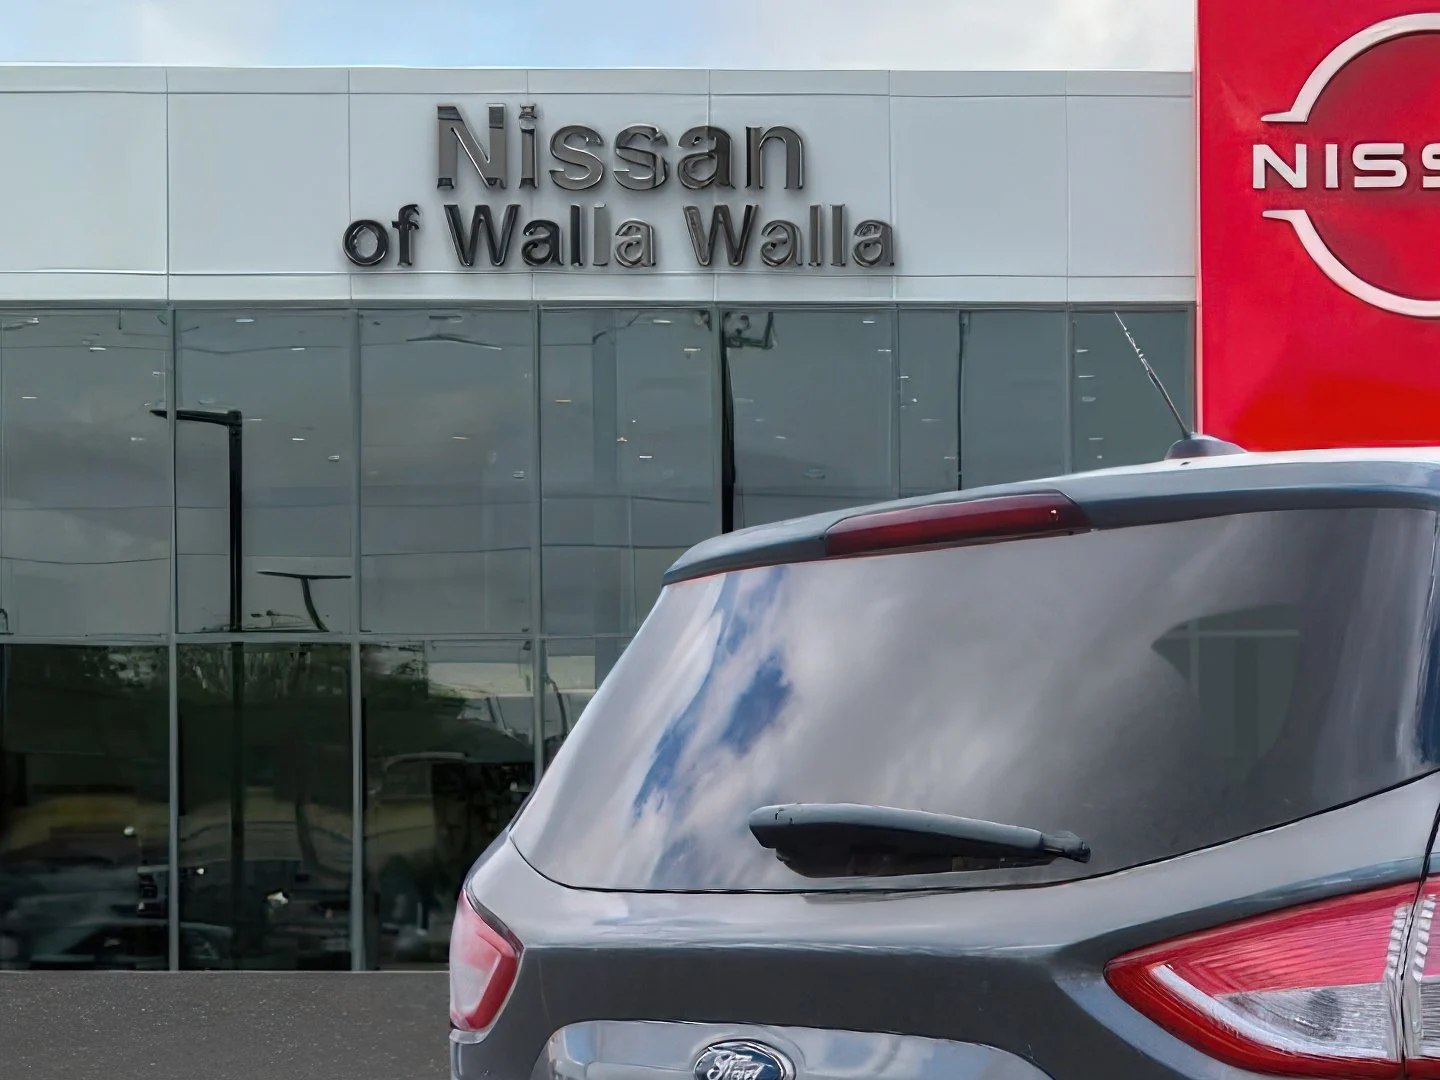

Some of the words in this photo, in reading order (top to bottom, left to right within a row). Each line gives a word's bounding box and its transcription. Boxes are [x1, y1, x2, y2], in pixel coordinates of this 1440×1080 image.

[435, 102, 805, 192] Nissan
[342, 203, 421, 267] of
[443, 203, 657, 267] Walla
[683, 203, 895, 267] Walla
